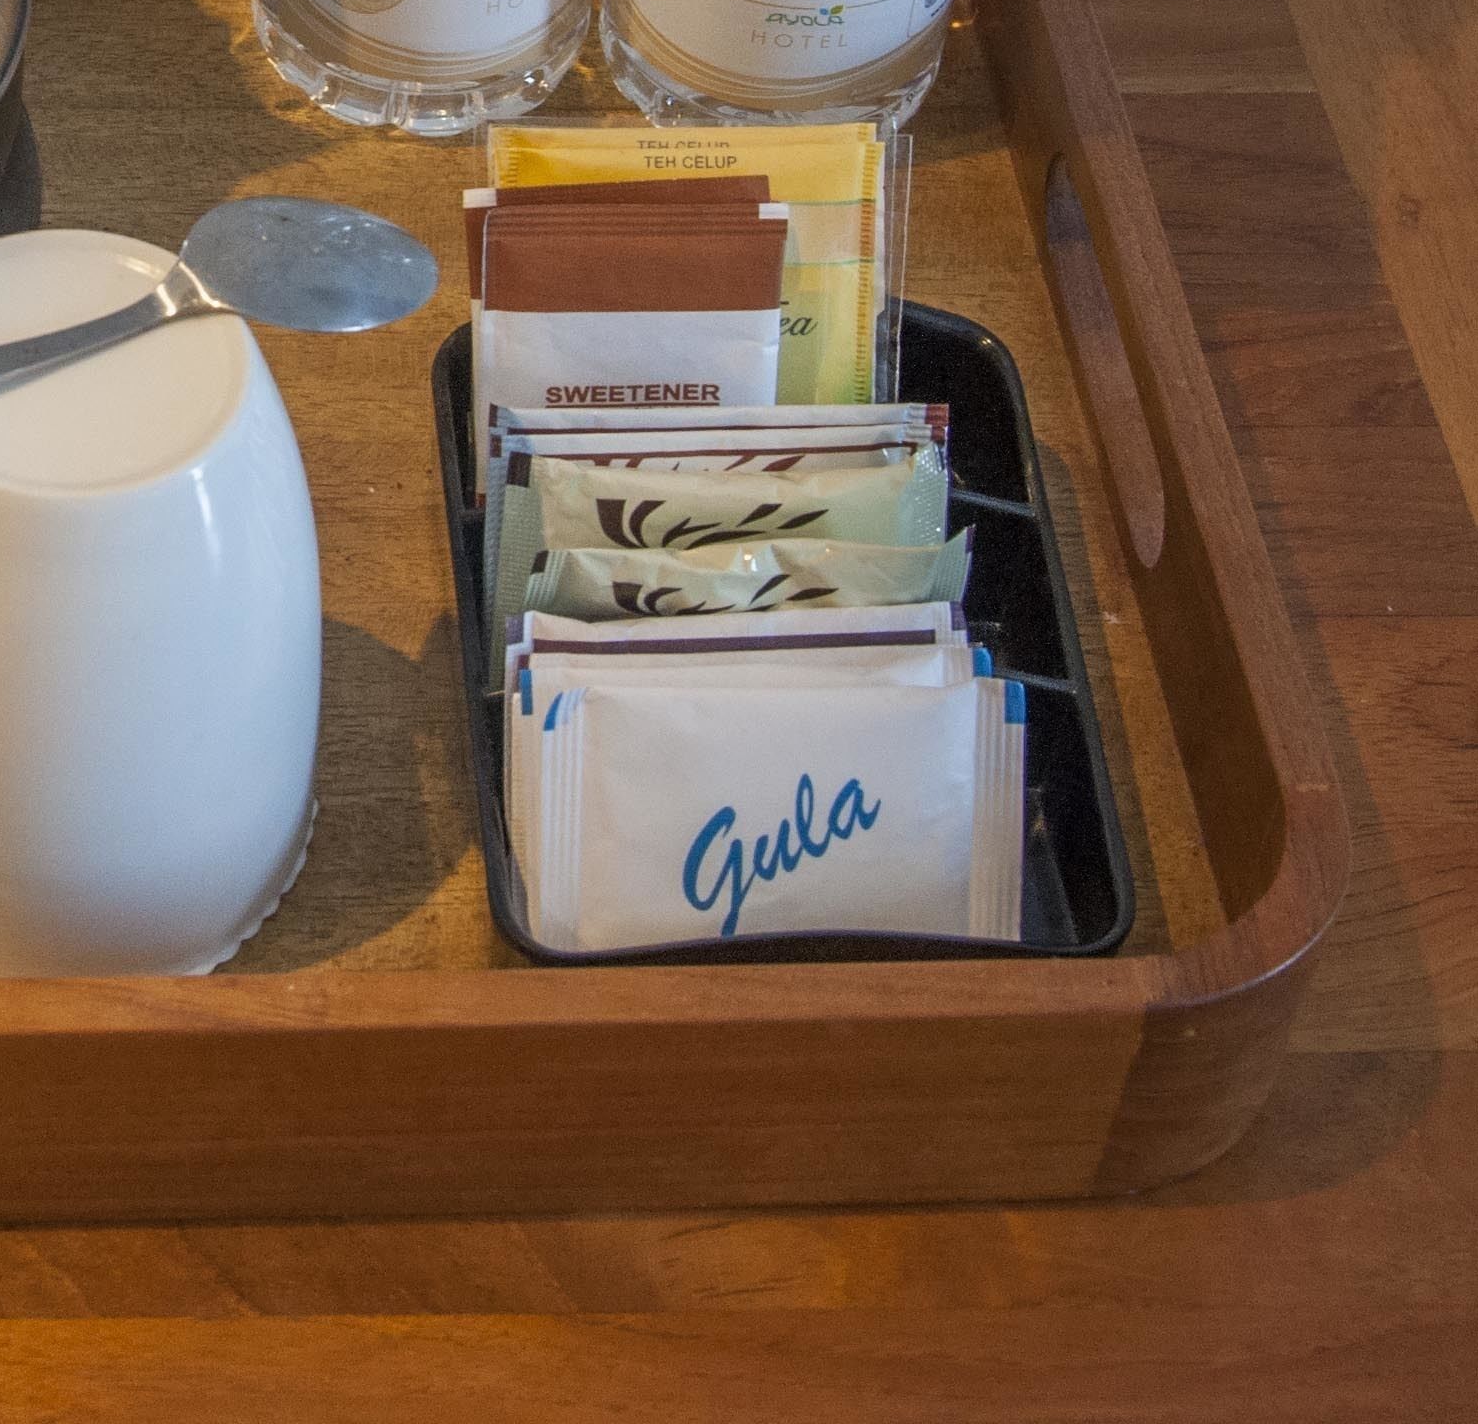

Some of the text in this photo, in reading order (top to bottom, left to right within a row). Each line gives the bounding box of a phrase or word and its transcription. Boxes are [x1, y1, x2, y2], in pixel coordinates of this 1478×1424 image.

[750, 29, 849, 50] HOTEL
[644, 155, 738, 169] TEH CELUP
[545, 383, 720, 403] SWEETENER
[682, 774, 881, 937] Gula
